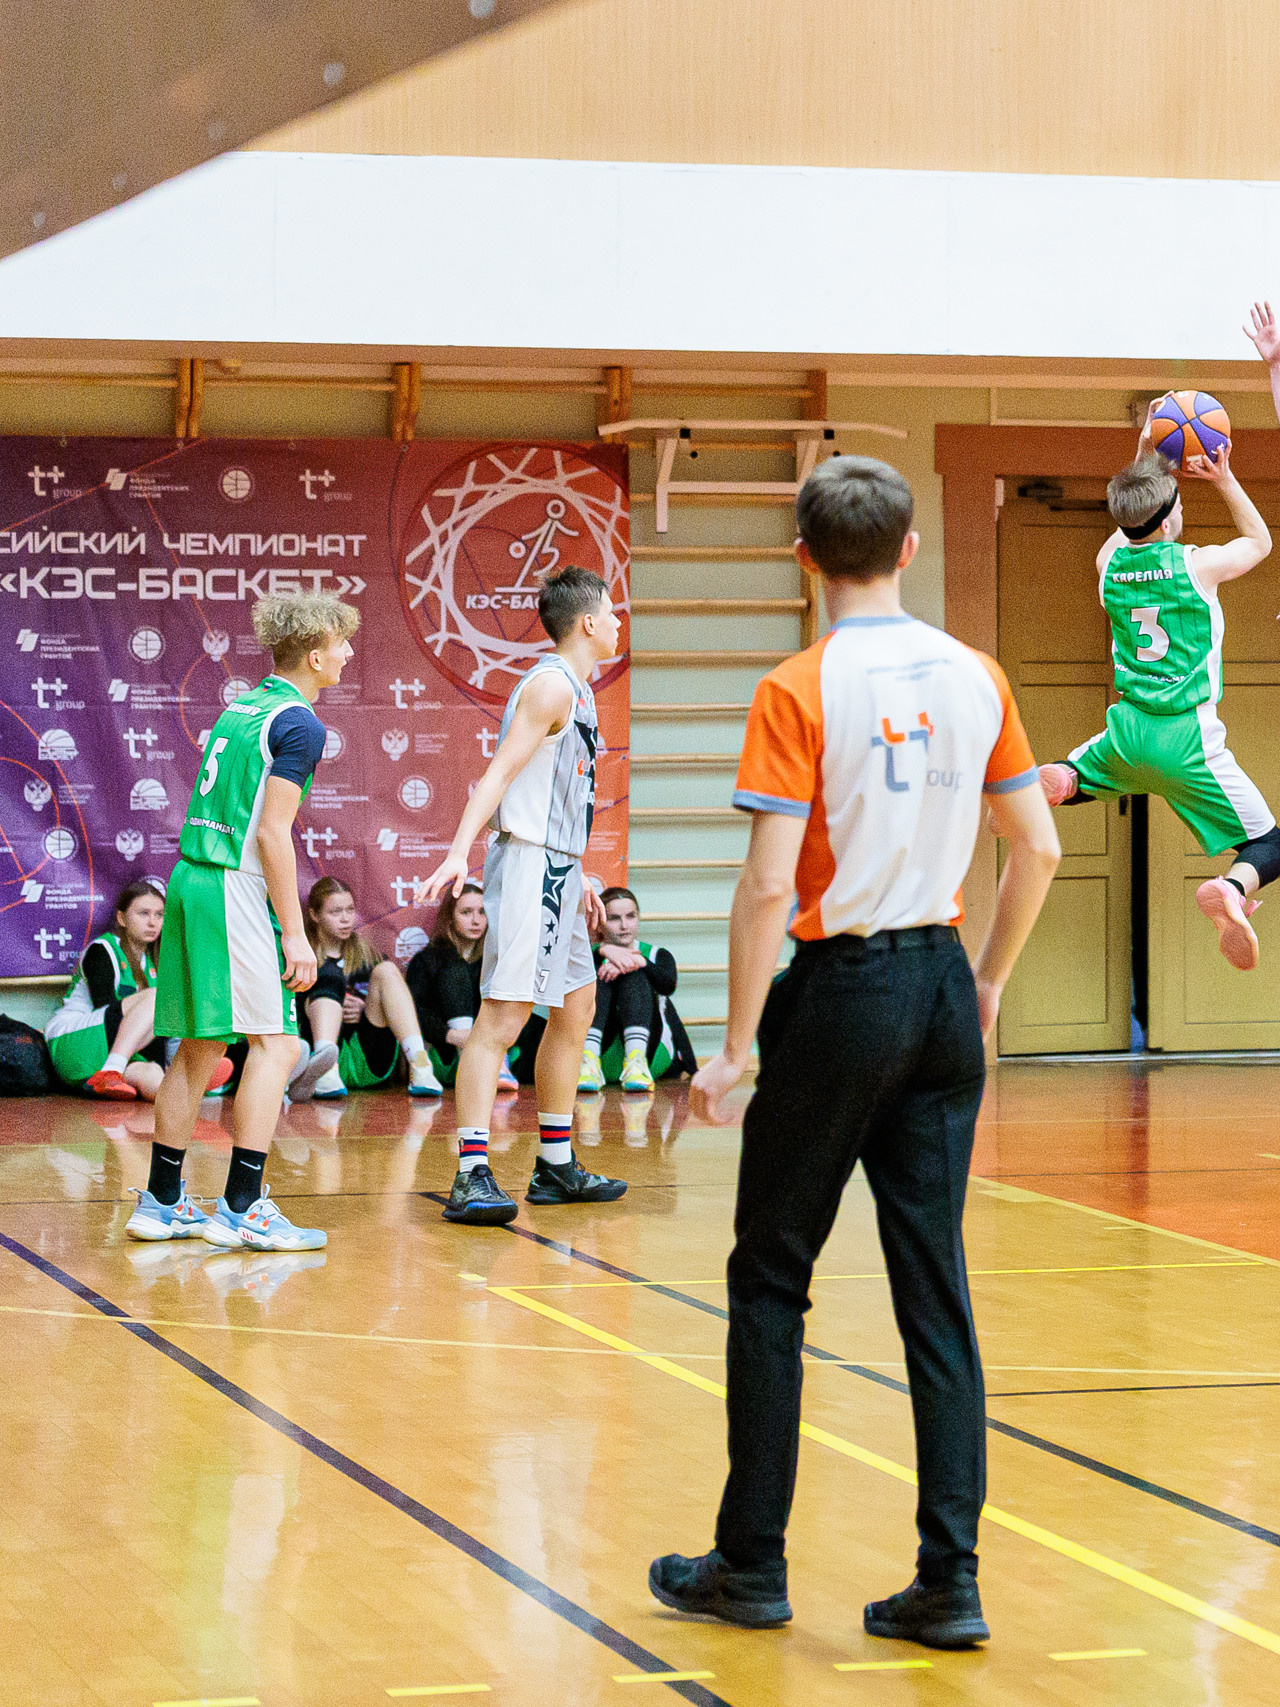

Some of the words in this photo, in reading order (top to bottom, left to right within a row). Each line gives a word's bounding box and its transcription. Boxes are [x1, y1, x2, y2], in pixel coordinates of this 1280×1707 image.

[163, 532, 368, 557] ЧЕМПИОНАТ
[1112, 569, 1173, 583] КАРЕЛИЯ
[466, 594, 539, 609] КЭС-БА
[1130, 606, 1170, 662] 3
[200, 737, 230, 797] 5
[58, 951, 80, 961] grou
